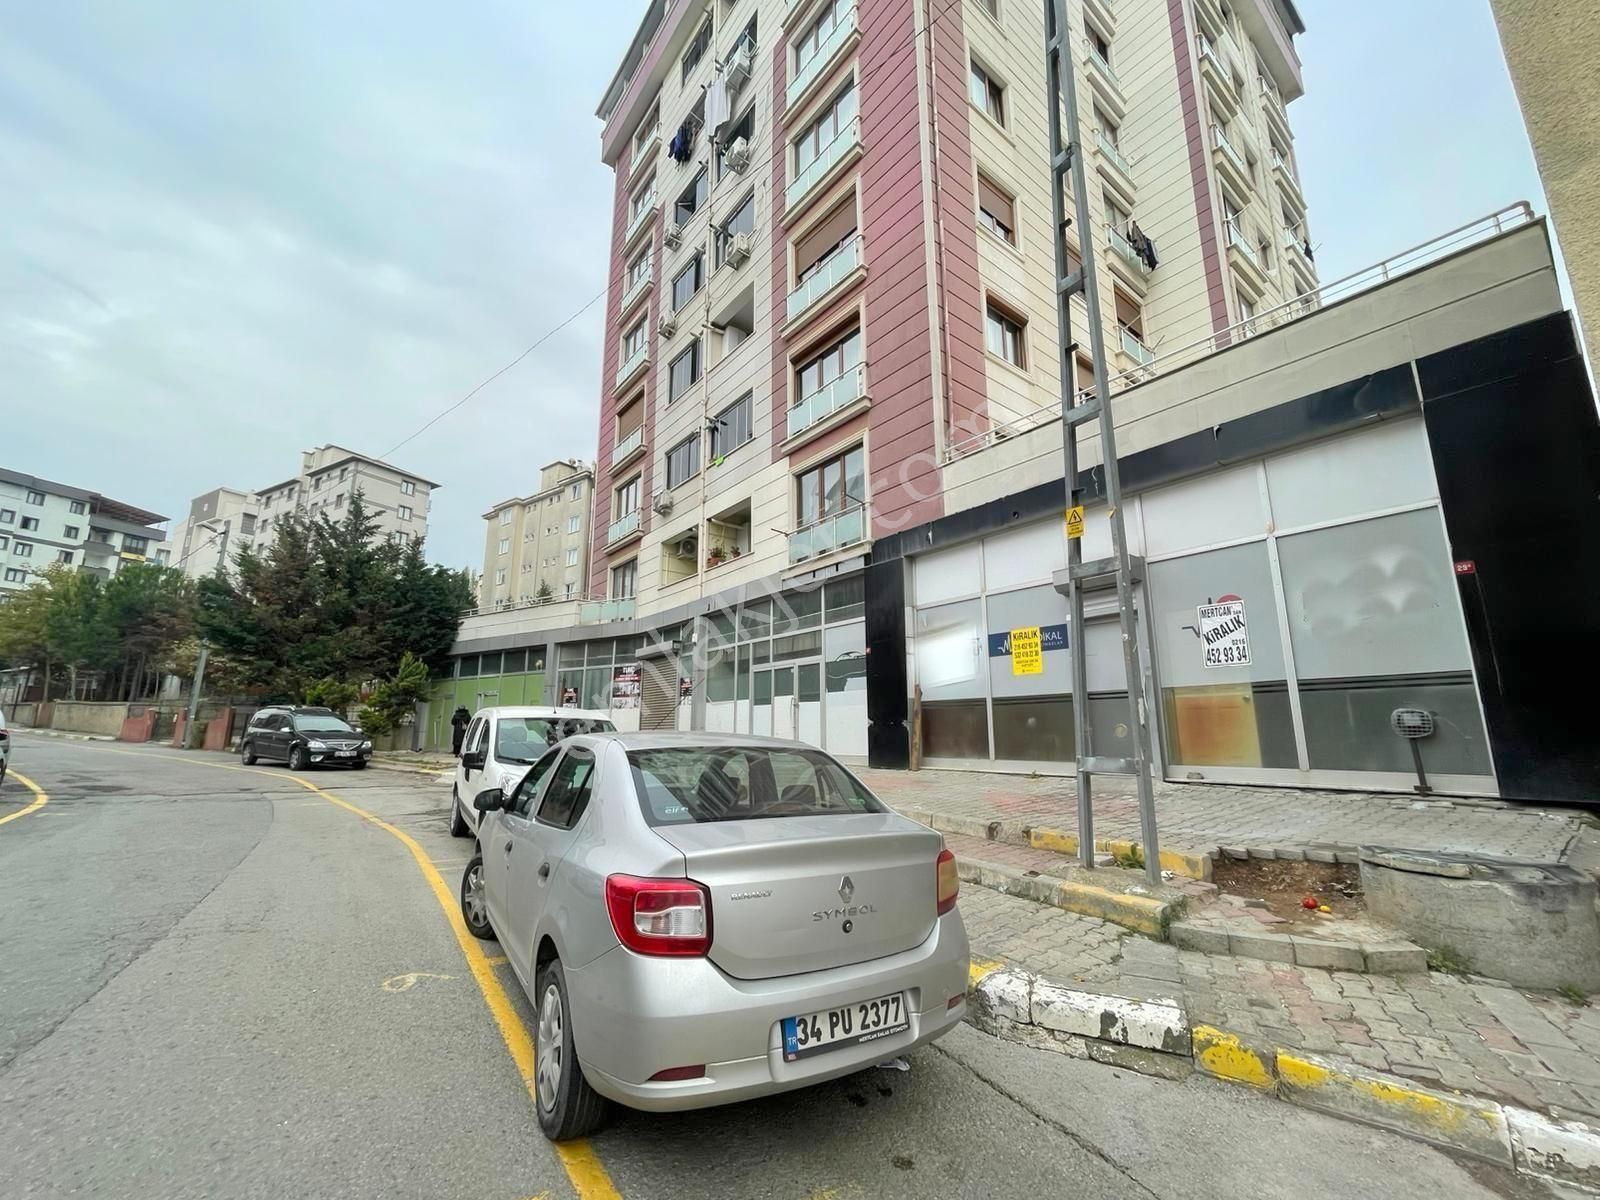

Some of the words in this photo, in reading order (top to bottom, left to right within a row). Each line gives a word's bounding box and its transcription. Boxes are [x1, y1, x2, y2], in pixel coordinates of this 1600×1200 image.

[1232, 638, 1246, 646] 0216
[1207, 647, 1222, 664] 452
[1223, 646, 1235, 663] 93
[1236, 645, 1248, 662] 34
[730, 890, 773, 901] RENAULT
[812, 904, 878, 922] SYMBOL
[797, 1015, 822, 1046] 34
[828, 1008, 853, 1039] PU
[858, 996, 901, 1031] 2377
[787, 1036, 796, 1046] TR
